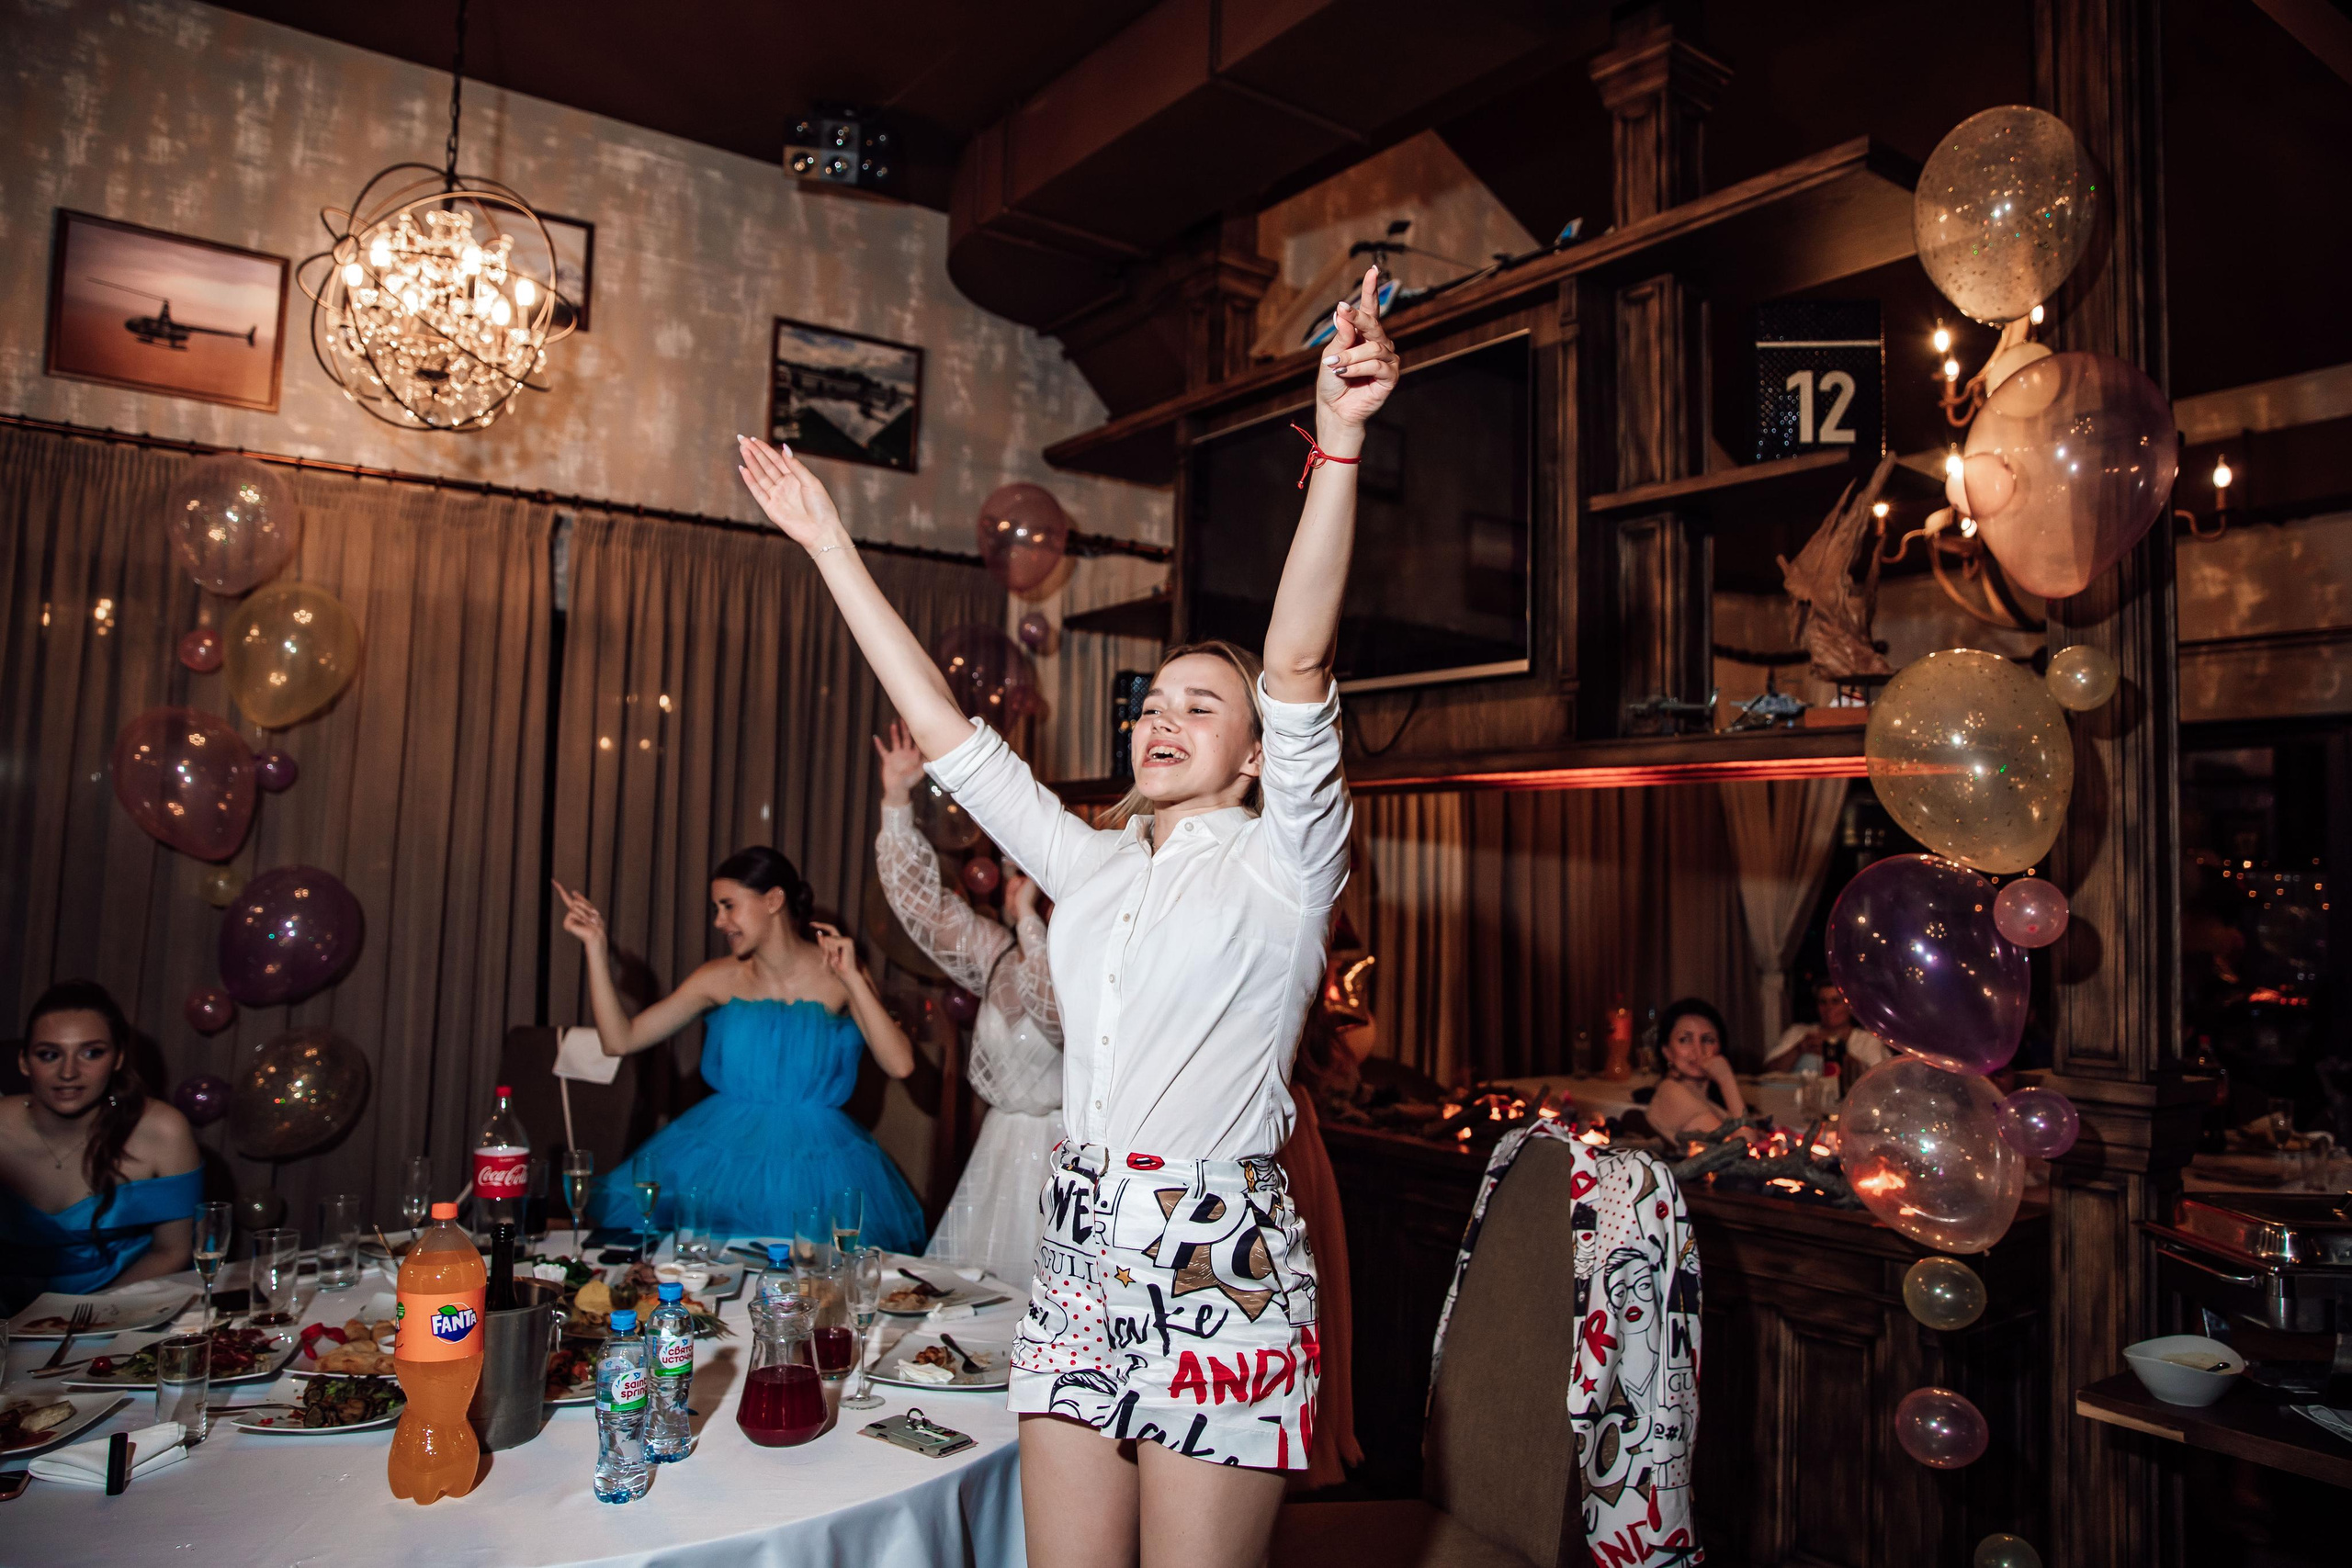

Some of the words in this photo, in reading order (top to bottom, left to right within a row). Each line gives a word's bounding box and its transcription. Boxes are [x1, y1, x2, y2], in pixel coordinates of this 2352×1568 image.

[1786, 370, 1856, 444] 12
[1048, 1176, 1093, 1246] WE
[431, 1309, 477, 1335] FANTA
[625, 1377, 647, 1390] saint
